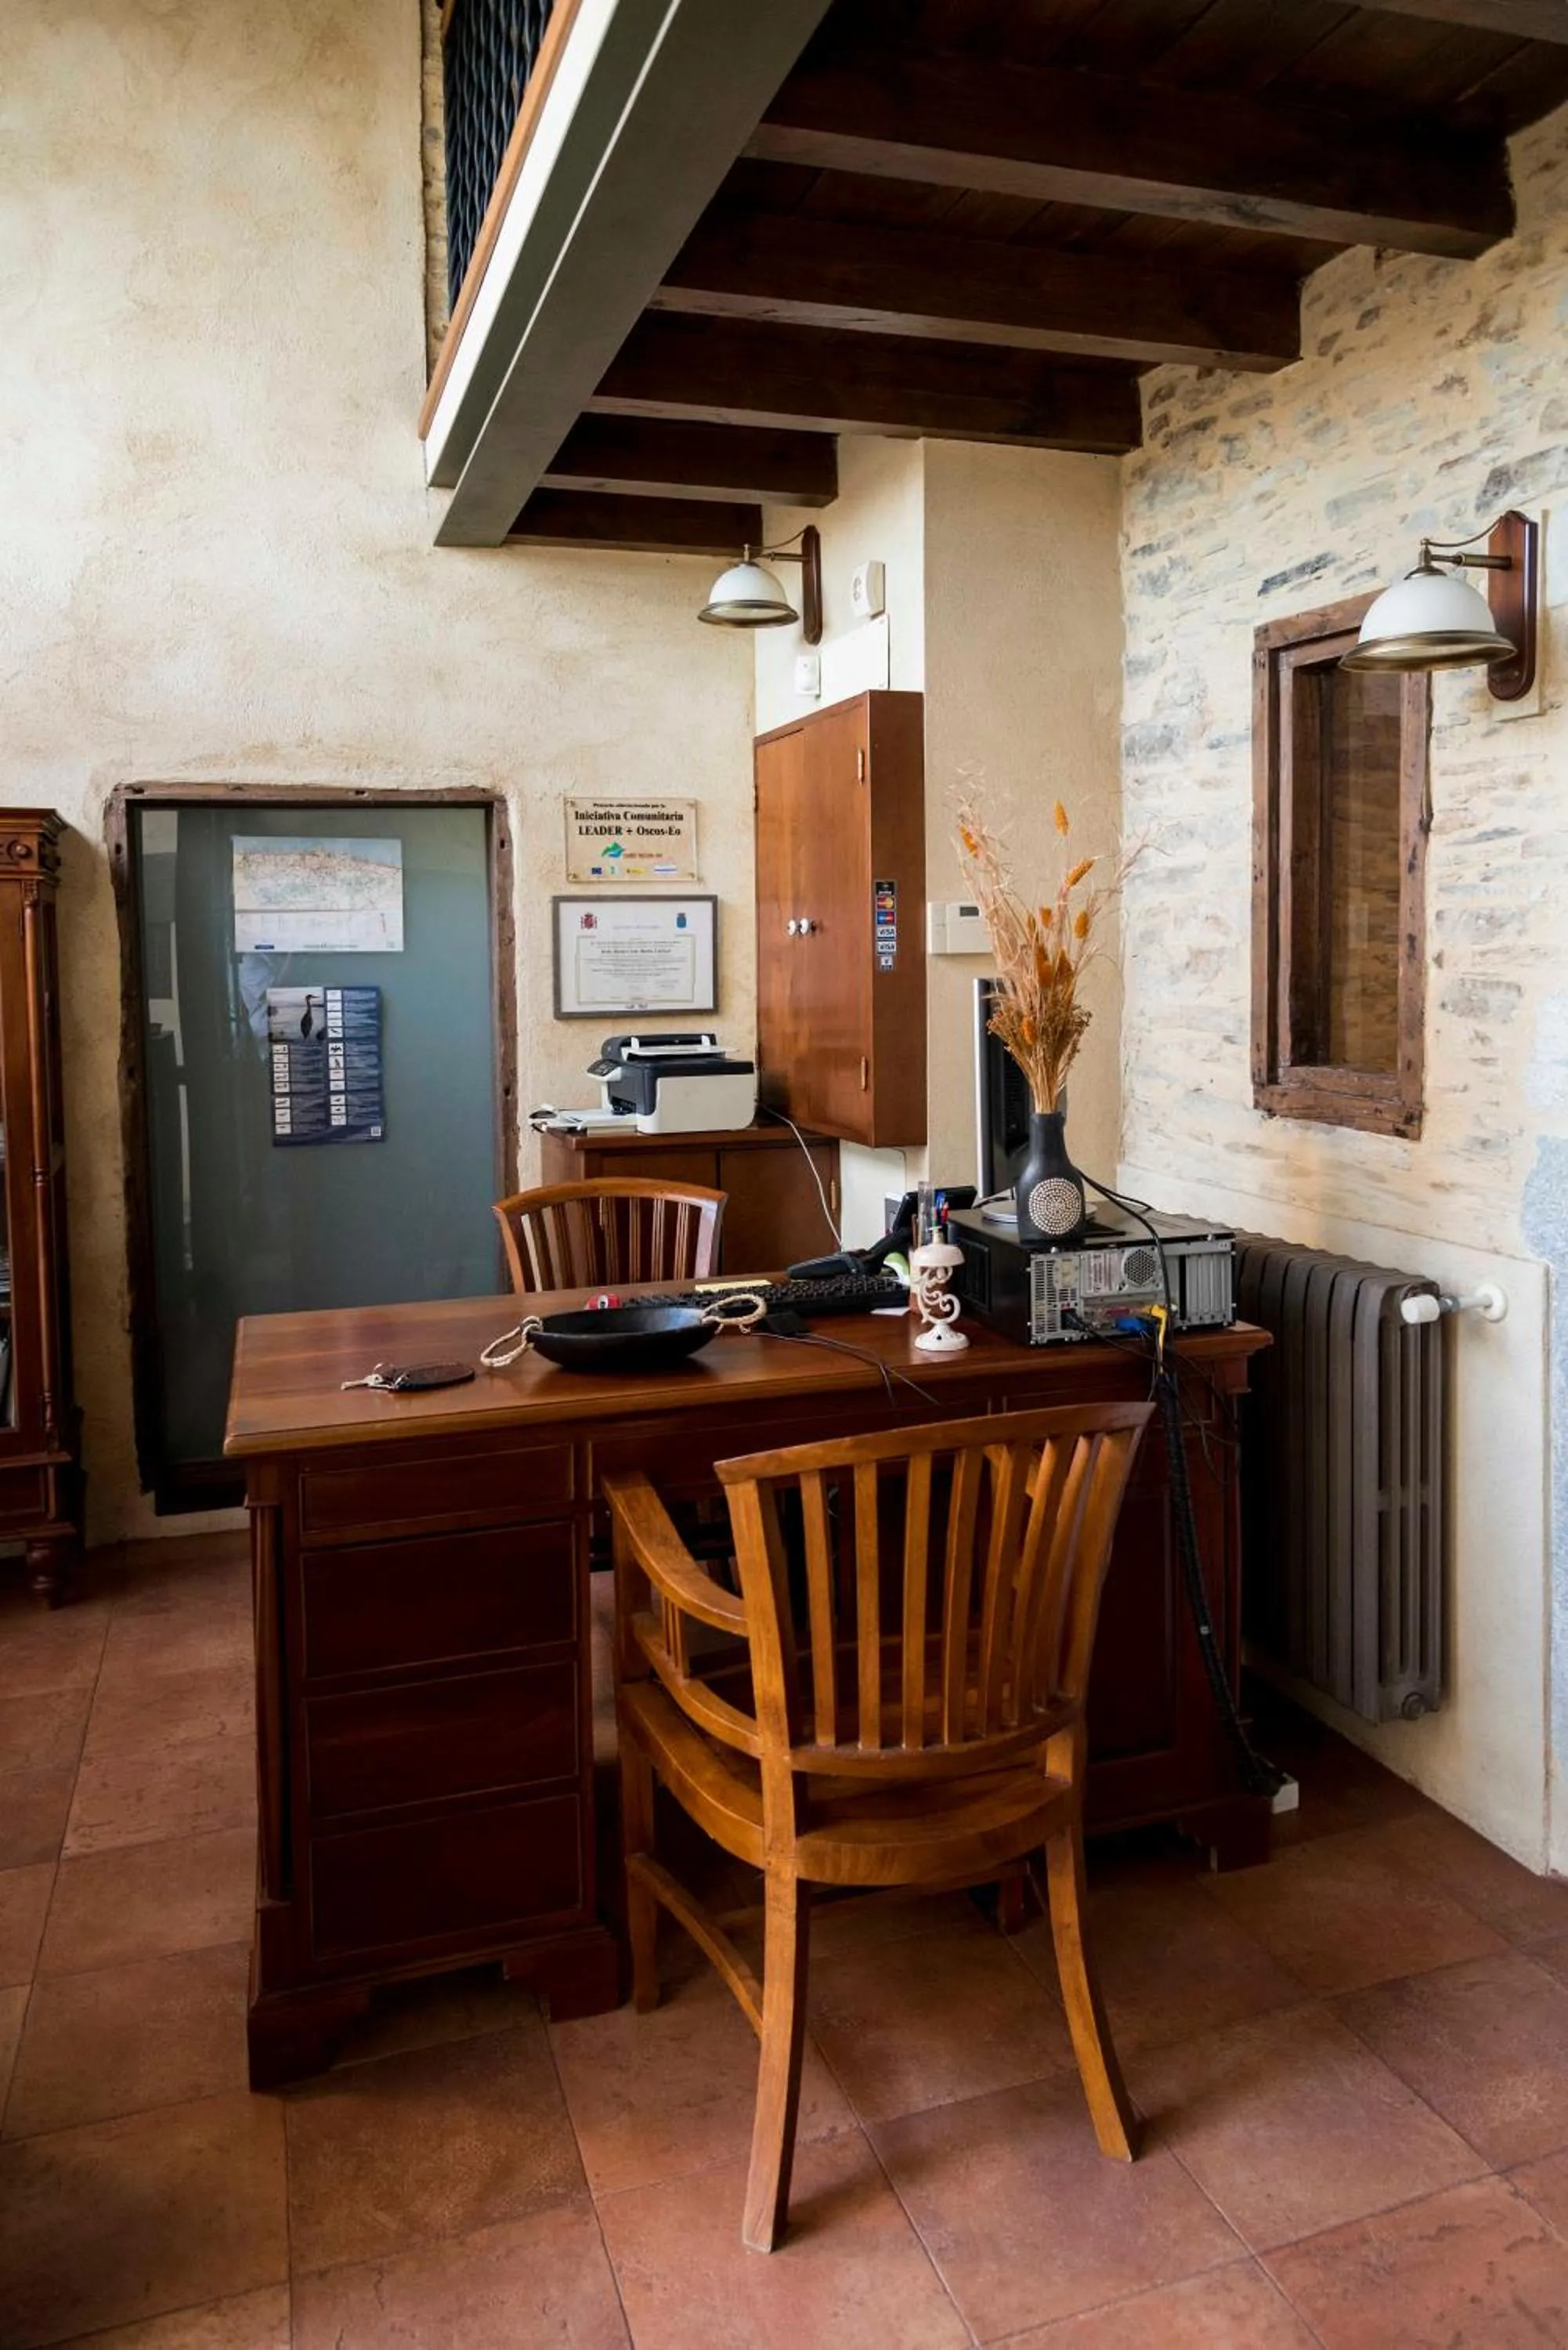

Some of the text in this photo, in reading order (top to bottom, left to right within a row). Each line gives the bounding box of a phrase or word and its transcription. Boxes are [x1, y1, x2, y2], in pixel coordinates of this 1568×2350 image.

[575, 811, 684, 821] Iniciativa Comunitaria
[579, 826, 623, 835] LEADER
[637, 826, 681, 835] Oscos-Eo
